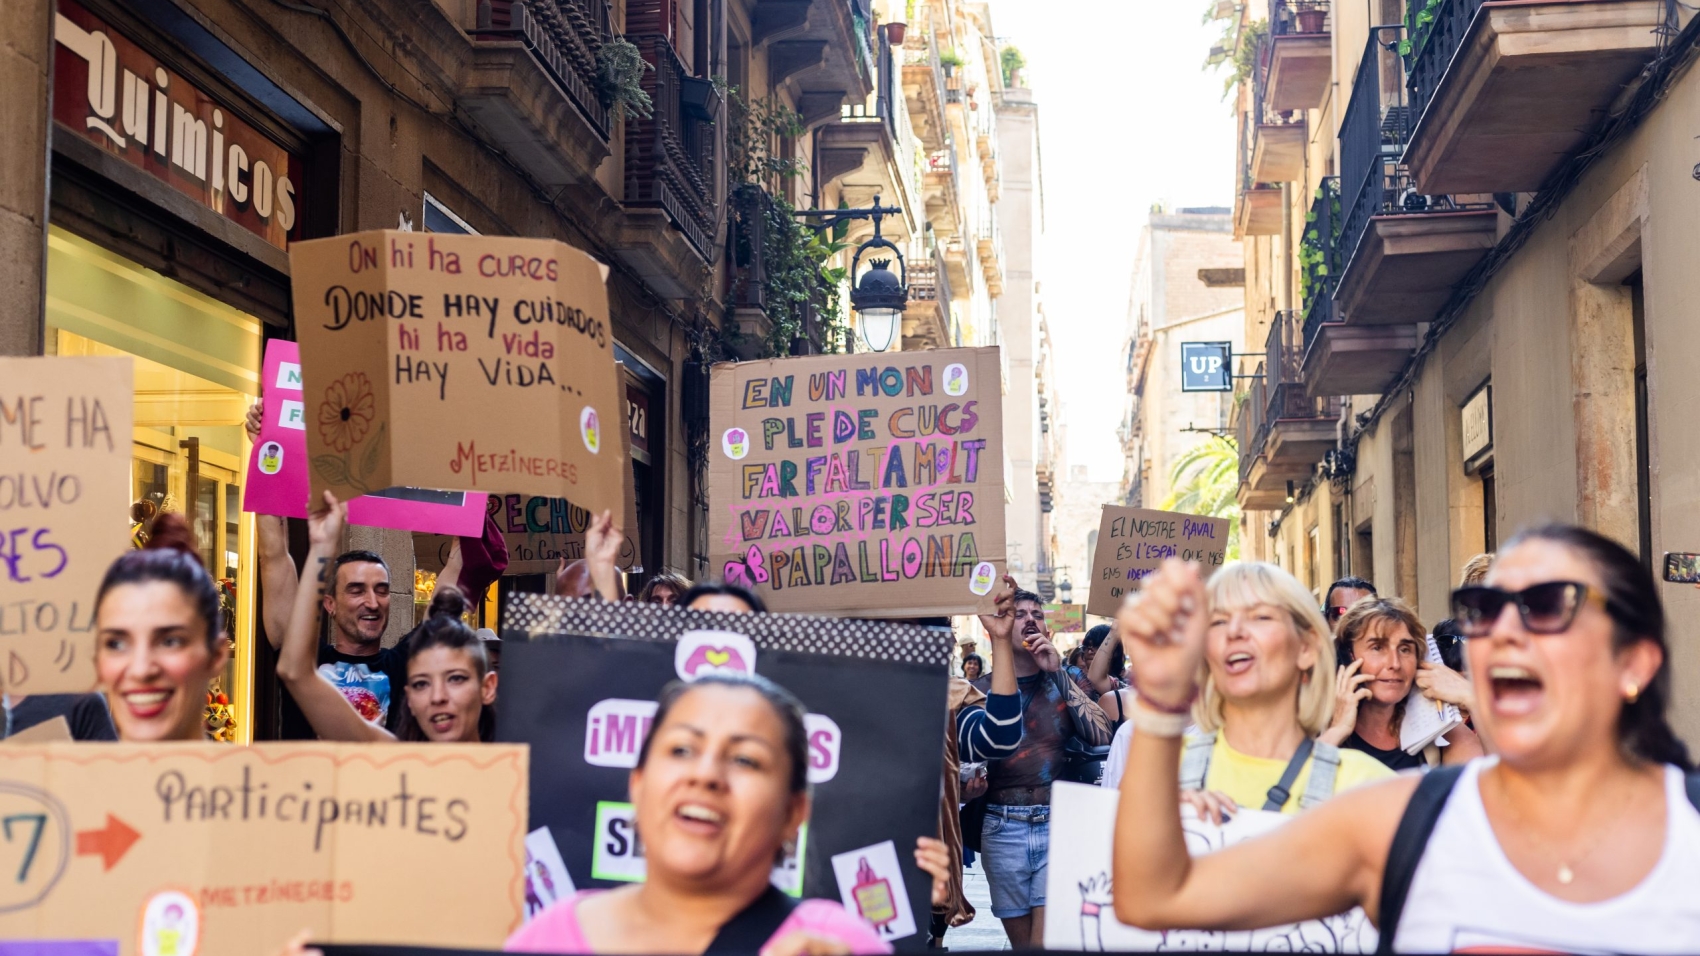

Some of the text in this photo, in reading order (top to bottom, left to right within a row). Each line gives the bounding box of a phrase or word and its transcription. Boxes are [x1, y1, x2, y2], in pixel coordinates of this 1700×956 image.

[55, 12, 295, 231] Quimicos
[391, 238, 413, 268] hi
[428, 237, 462, 274] ha
[323, 285, 424, 331] DONDE
[444, 293, 499, 338] HAY
[398, 322, 420, 351] hi
[437, 321, 468, 352] ha
[395, 354, 448, 400] HAY
[741, 365, 933, 409] EN UN MON
[1190, 356, 1222, 374] UP
[66, 396, 115, 452] HA
[761, 401, 979, 450] PLE DE CUCS
[742, 439, 986, 499] FAR FALTA MOLT
[740, 490, 976, 541] VALOR PER SER
[1130, 518, 1175, 539] NOSTRE
[1182, 518, 1215, 540] RAVAL
[769, 532, 979, 590] PAPALLONA
[1103, 567, 1121, 580] ENS
[1111, 587, 1123, 598] ON
